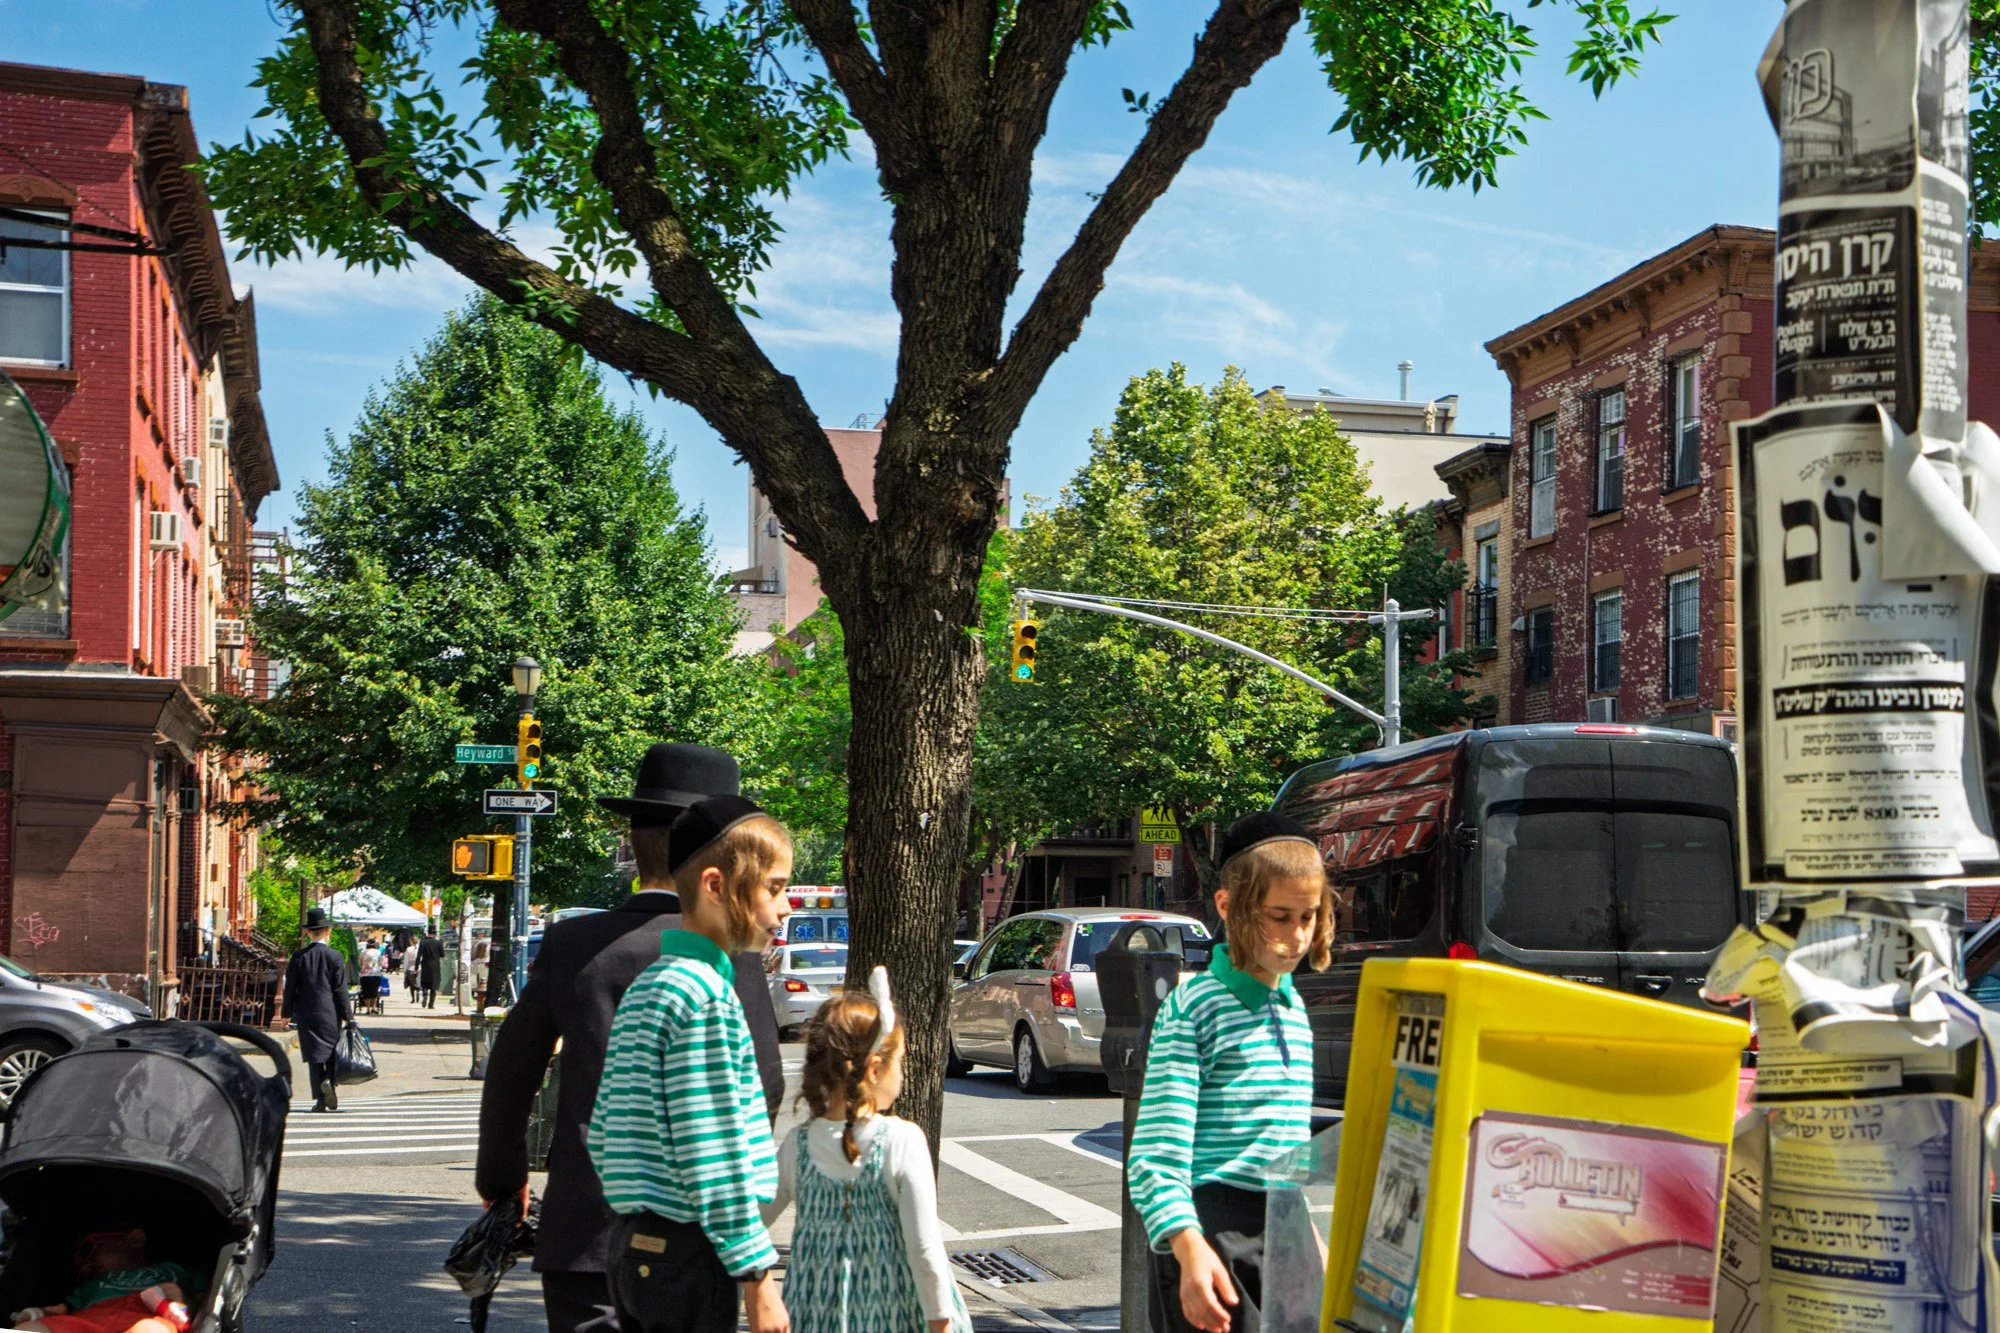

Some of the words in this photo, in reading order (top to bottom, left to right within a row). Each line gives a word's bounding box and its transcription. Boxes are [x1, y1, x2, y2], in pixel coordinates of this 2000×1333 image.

[1839, 232, 1895, 279] קרן
[456, 746, 504, 762] Heyward
[495, 797, 515, 807] ONE
[524, 797, 546, 807] WAY
[1864, 807, 1898, 820] 8:00
[1145, 830, 1177, 840] AHEAD
[1392, 1015, 1442, 1067] FRE
